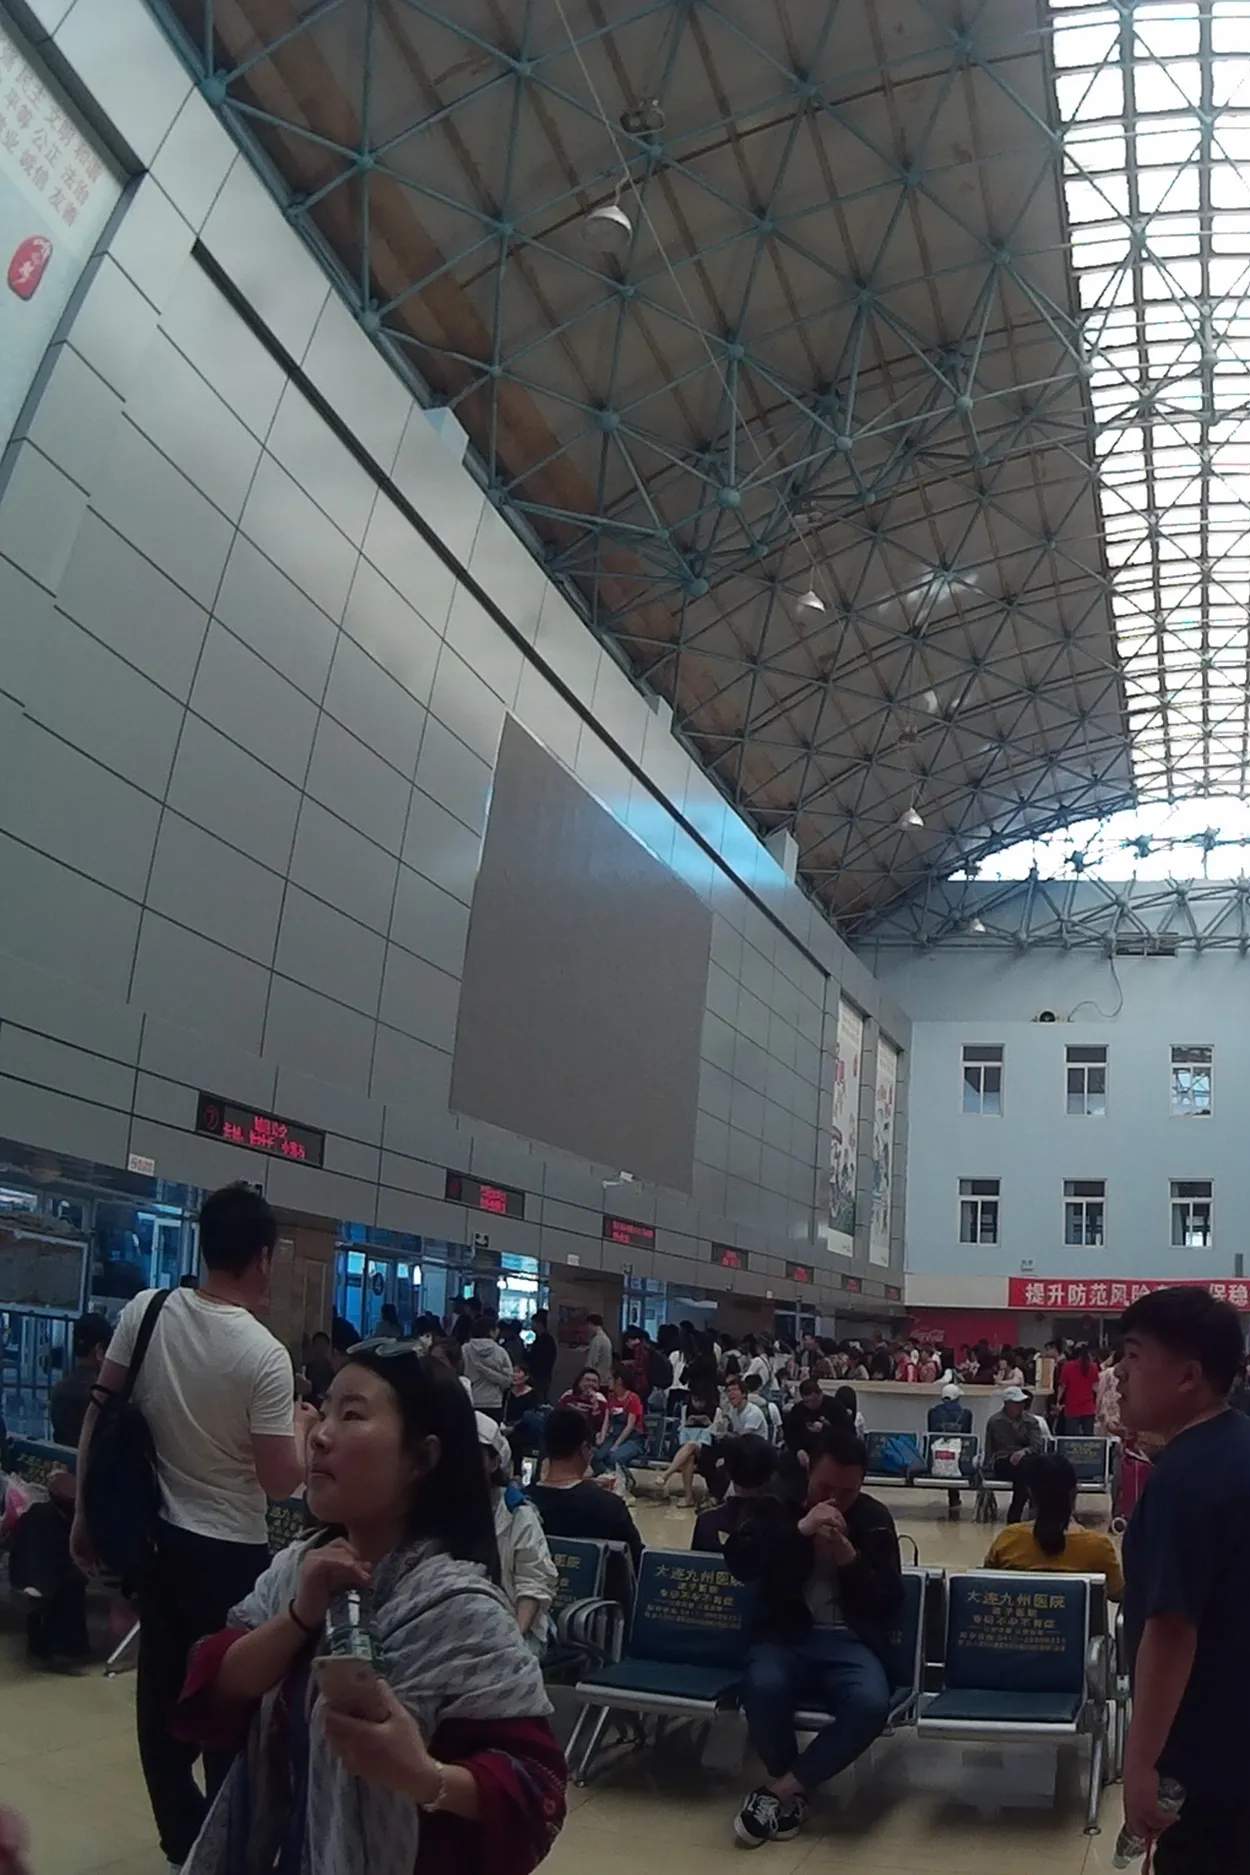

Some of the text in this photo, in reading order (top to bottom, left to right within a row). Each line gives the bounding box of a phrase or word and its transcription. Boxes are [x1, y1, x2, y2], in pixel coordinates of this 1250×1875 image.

[967, 1589, 1066, 1609] 大连九州医院
